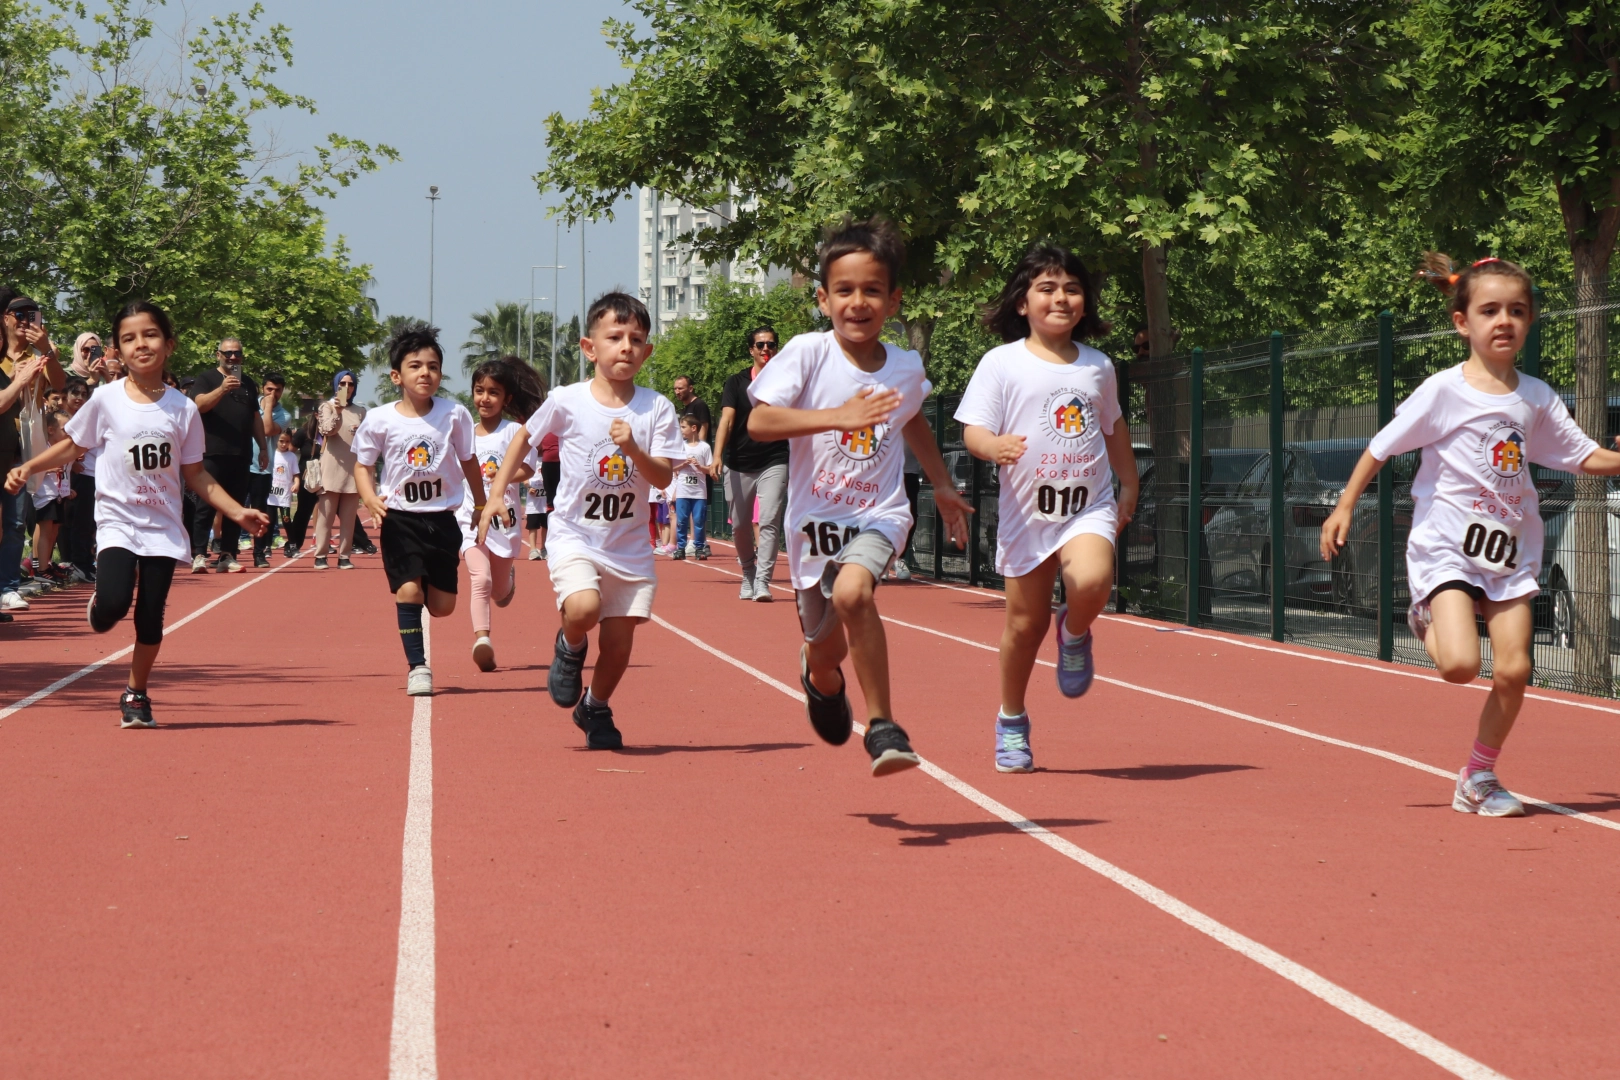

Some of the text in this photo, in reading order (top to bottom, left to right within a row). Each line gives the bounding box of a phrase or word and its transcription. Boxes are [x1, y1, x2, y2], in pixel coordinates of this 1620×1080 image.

[128, 442, 172, 471] 168
[1041, 452, 1095, 464] 23 Nisan
[684, 476, 698, 484] 125
[818, 470, 879, 494] 23 Nisan
[1036, 468, 1097, 480] Koşusu
[137, 486, 148, 494] 23
[404, 478, 442, 504] 001
[1038, 484, 1088, 516] 010
[585, 492, 636, 522] 202
[1463, 523, 1517, 570] 002
